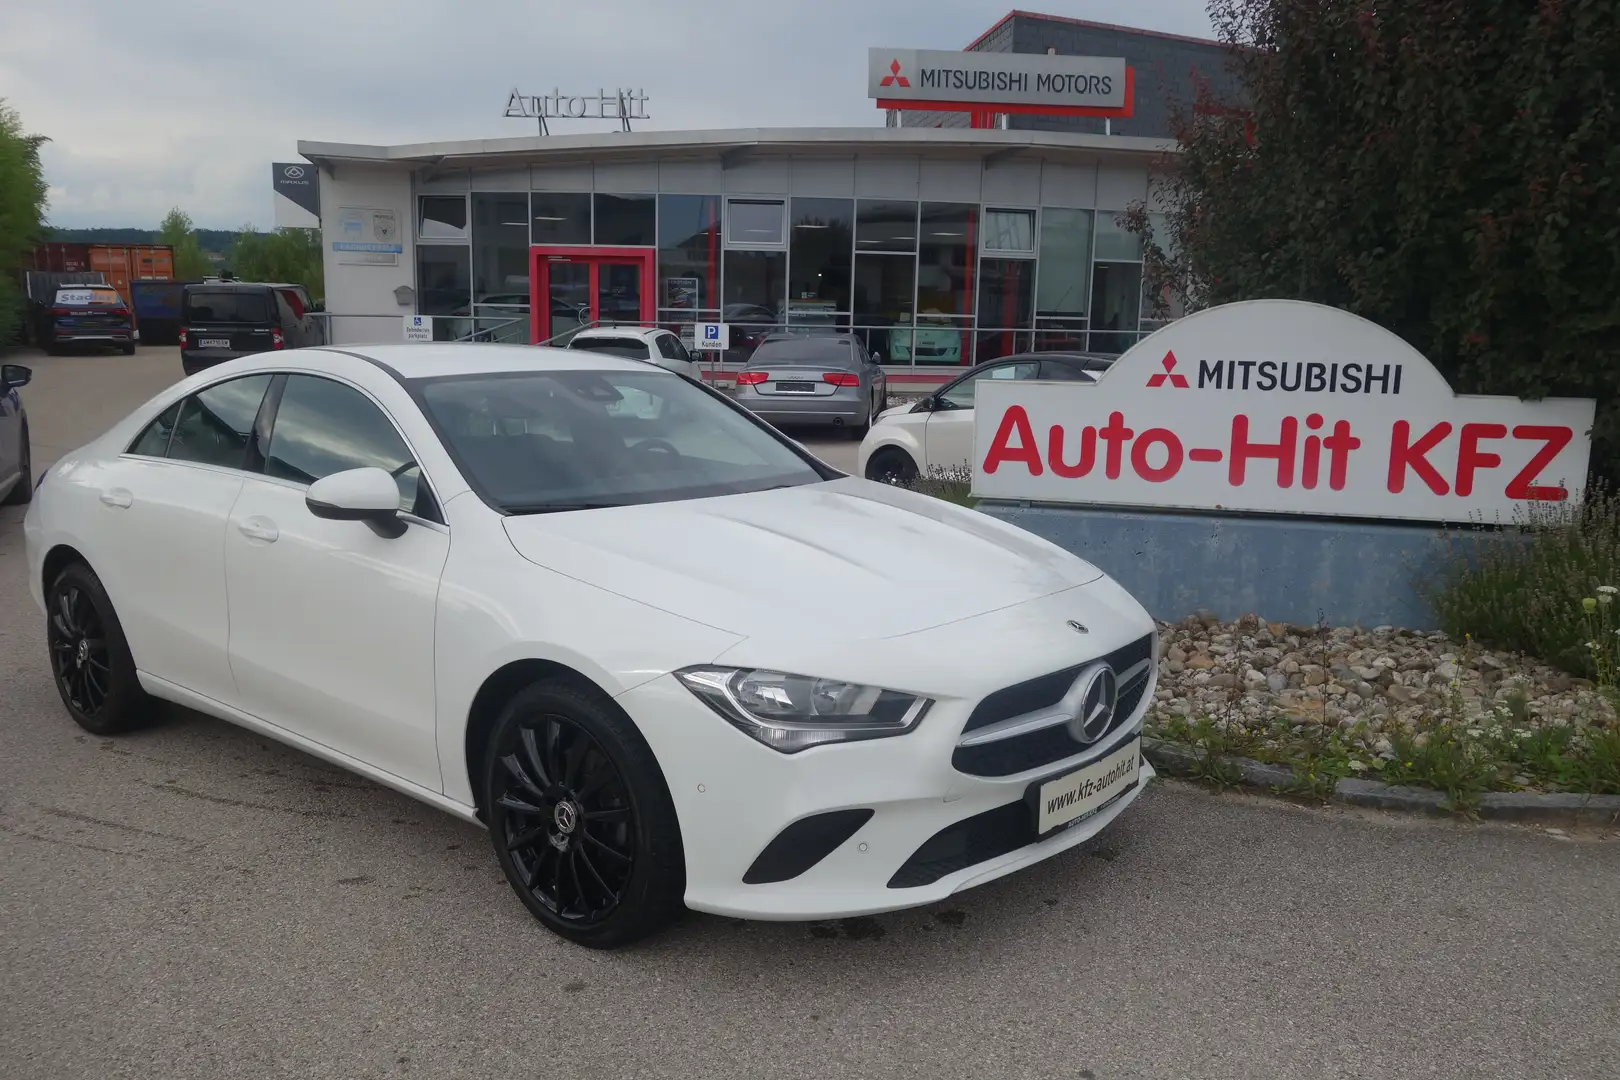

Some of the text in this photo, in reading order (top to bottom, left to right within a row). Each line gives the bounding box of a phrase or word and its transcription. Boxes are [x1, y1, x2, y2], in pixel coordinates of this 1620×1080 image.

[920, 68, 1112, 95] MITSUBISHI MOTORS
[502, 86, 650, 118] Auto Hit
[707, 326, 716, 339] P
[1198, 359, 1402, 395] MITSUBISHI
[982, 404, 1573, 501] Auto-Hit KFZ
[1047, 753, 1135, 815] www.kfz-autohit.at
